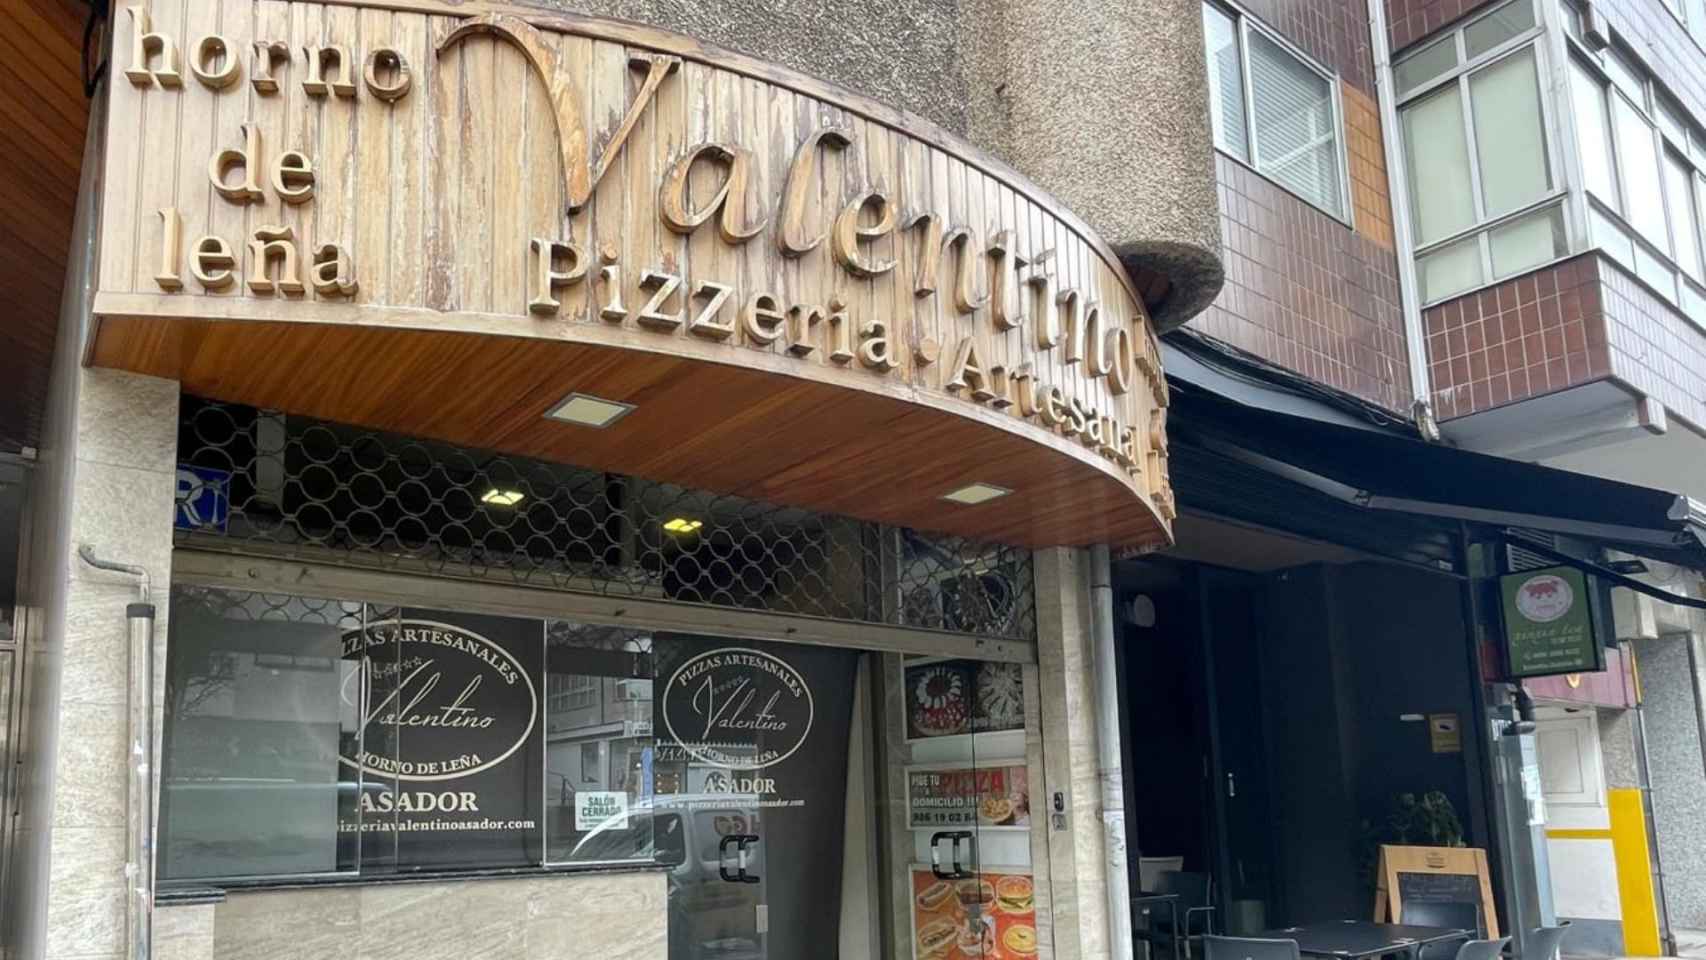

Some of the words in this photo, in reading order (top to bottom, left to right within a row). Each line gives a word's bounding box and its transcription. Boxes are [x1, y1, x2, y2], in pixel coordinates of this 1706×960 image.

[125, 5, 412, 101] horno
[208, 122, 315, 203] de
[435, 14, 1134, 396] Valentino
[154, 207, 359, 296] leña
[528, 238, 900, 372] Pizzeria
[946, 337, 1142, 476] Artesana
[391, 628, 519, 685] ARTESANALES
[678, 656, 722, 686] PIZZAS
[723, 653, 803, 698] ARTESANALES
[340, 655, 496, 741] Valentino
[692, 674, 788, 740] Valentino
[355, 750, 413, 774] HORNO
[417, 762, 439, 775] DE
[442, 752, 483, 773] LEÑA
[703, 777, 776, 794] ASADOR
[354, 791, 479, 813] ASADOR
